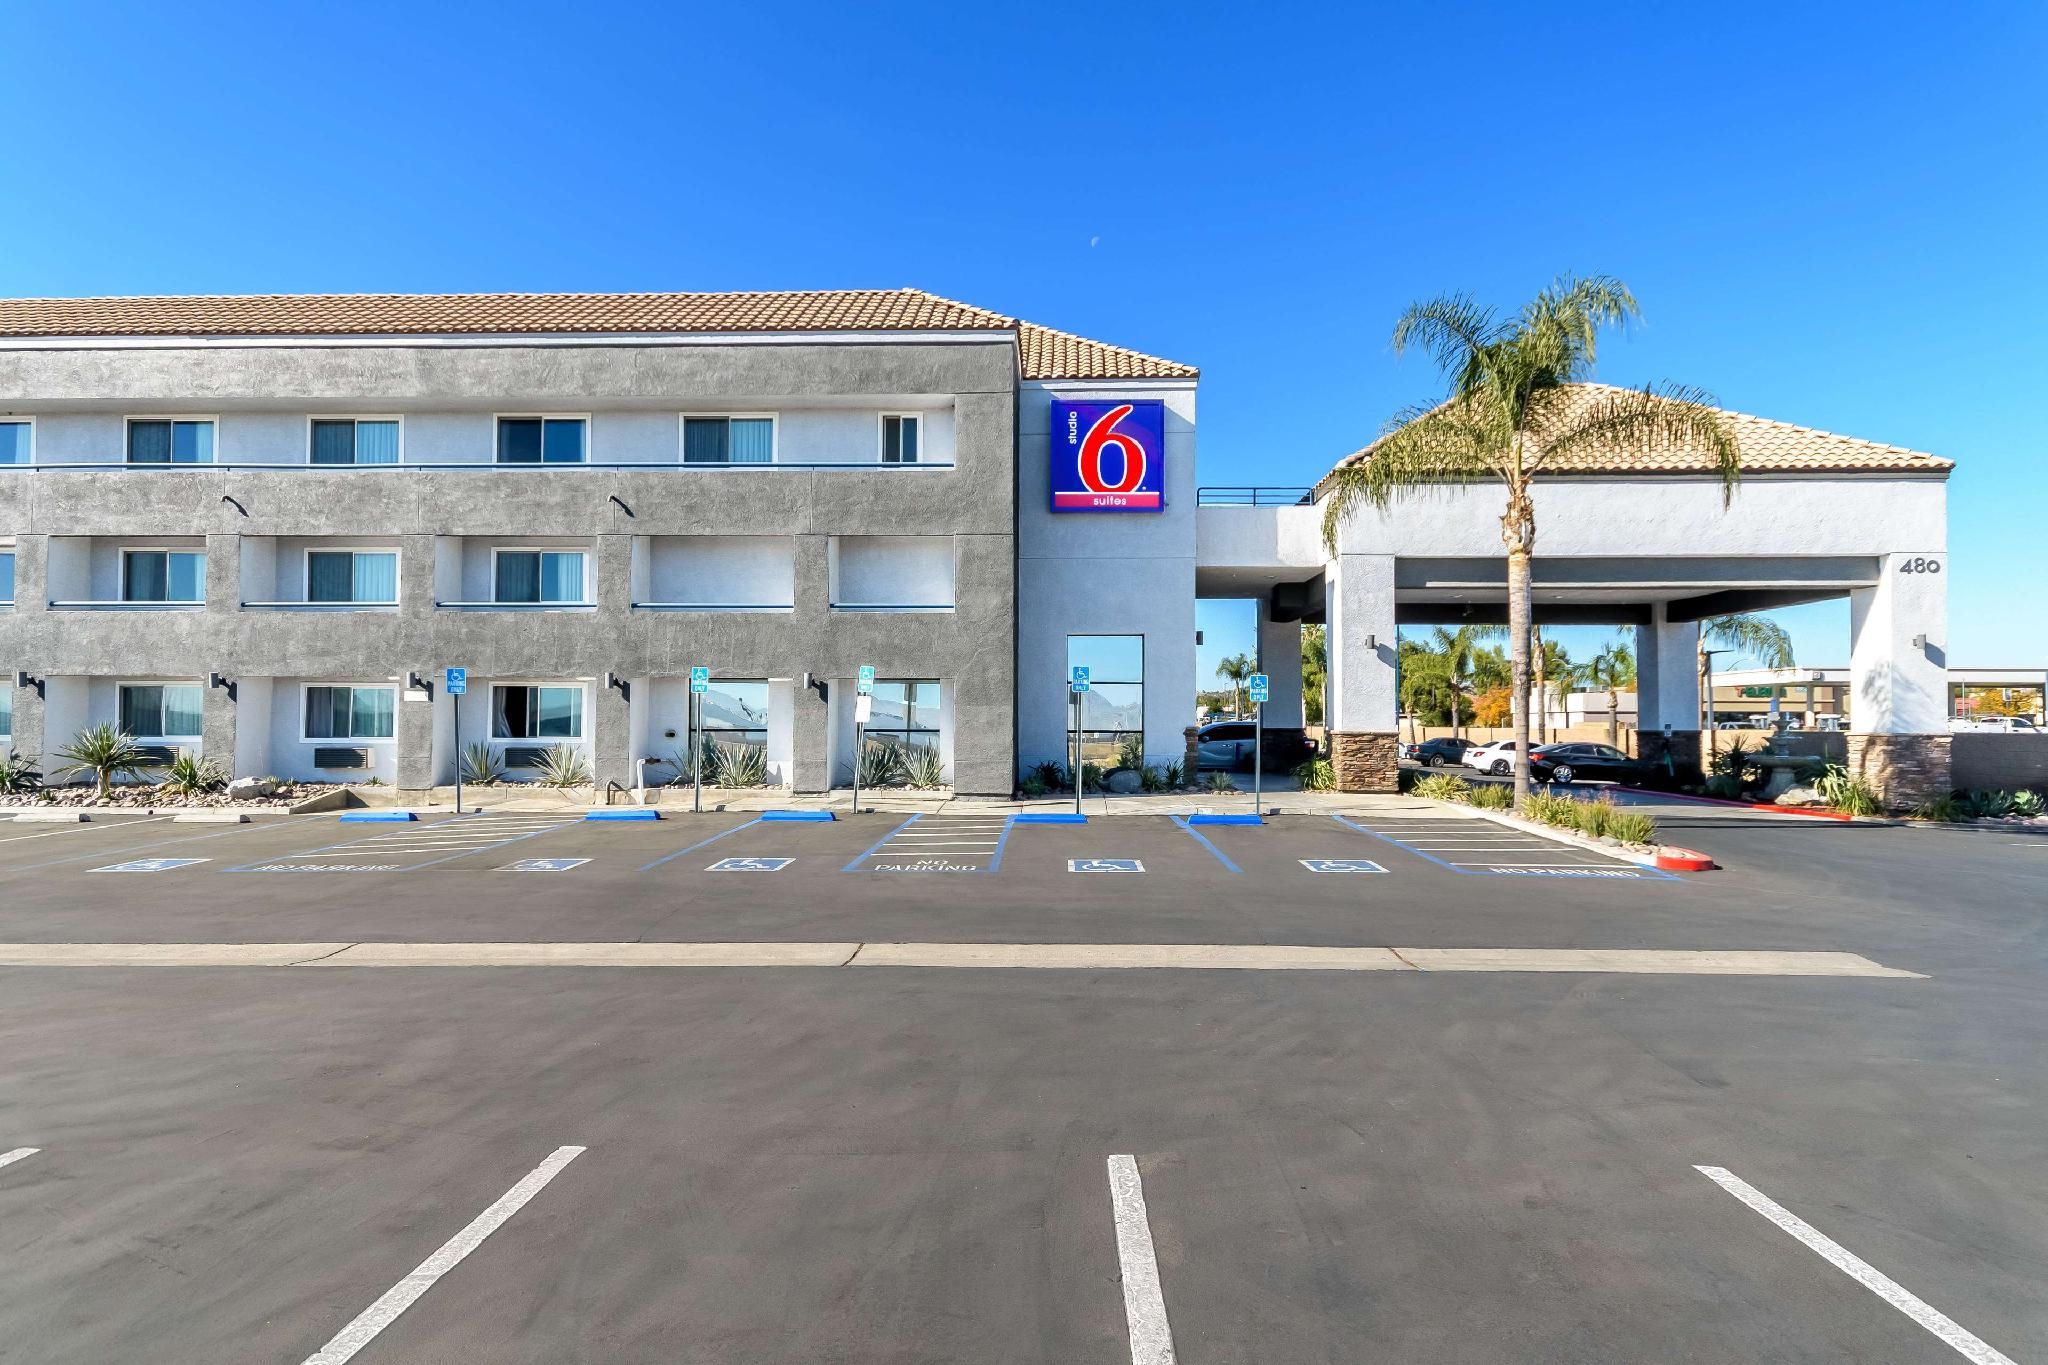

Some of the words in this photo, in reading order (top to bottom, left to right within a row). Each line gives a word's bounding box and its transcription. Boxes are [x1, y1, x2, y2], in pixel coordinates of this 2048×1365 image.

[1068, 411, 1078, 445] studio
[1077, 404, 1147, 493] 6
[1093, 496, 1127, 506] suites
[1899, 557, 1941, 574] 480
[1528, 868, 1640, 877] PARKING
